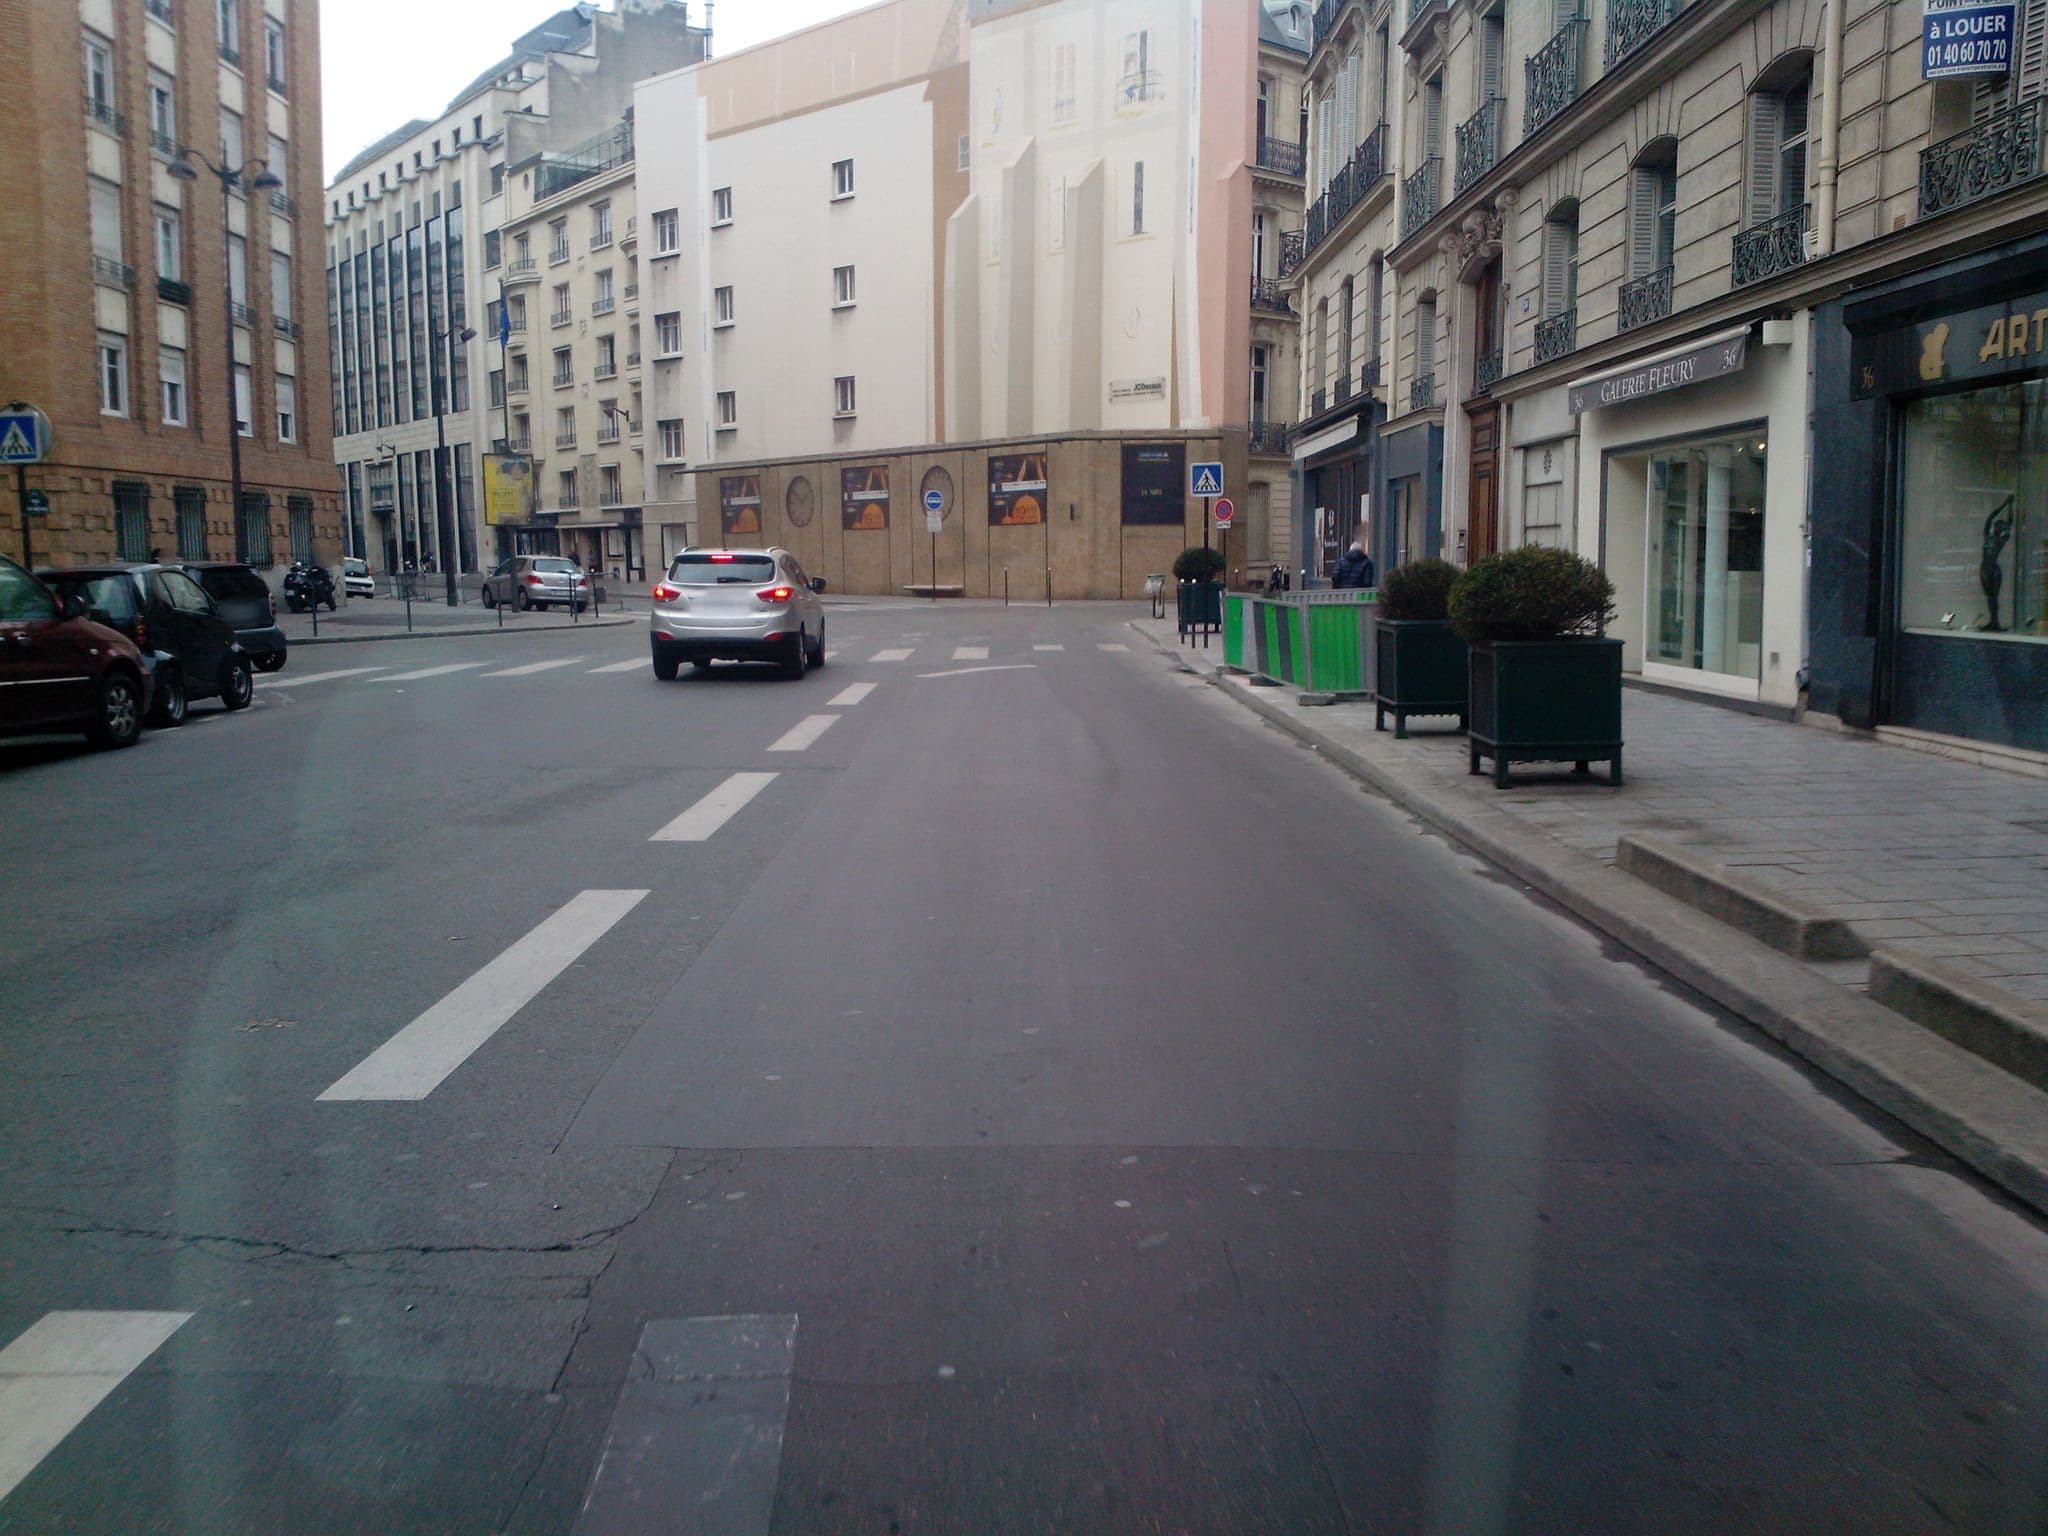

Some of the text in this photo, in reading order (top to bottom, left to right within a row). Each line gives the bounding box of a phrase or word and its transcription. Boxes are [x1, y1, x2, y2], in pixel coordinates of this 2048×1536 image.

[1930, 15, 2006, 39] à LOUER
[1928, 38, 2007, 66] 01 40 60 70 70
[1979, 309, 2048, 363] ART
[1600, 373, 1646, 402] GALERIE
[1649, 357, 1698, 390] FLEURY
[1722, 347, 1737, 369] 36
